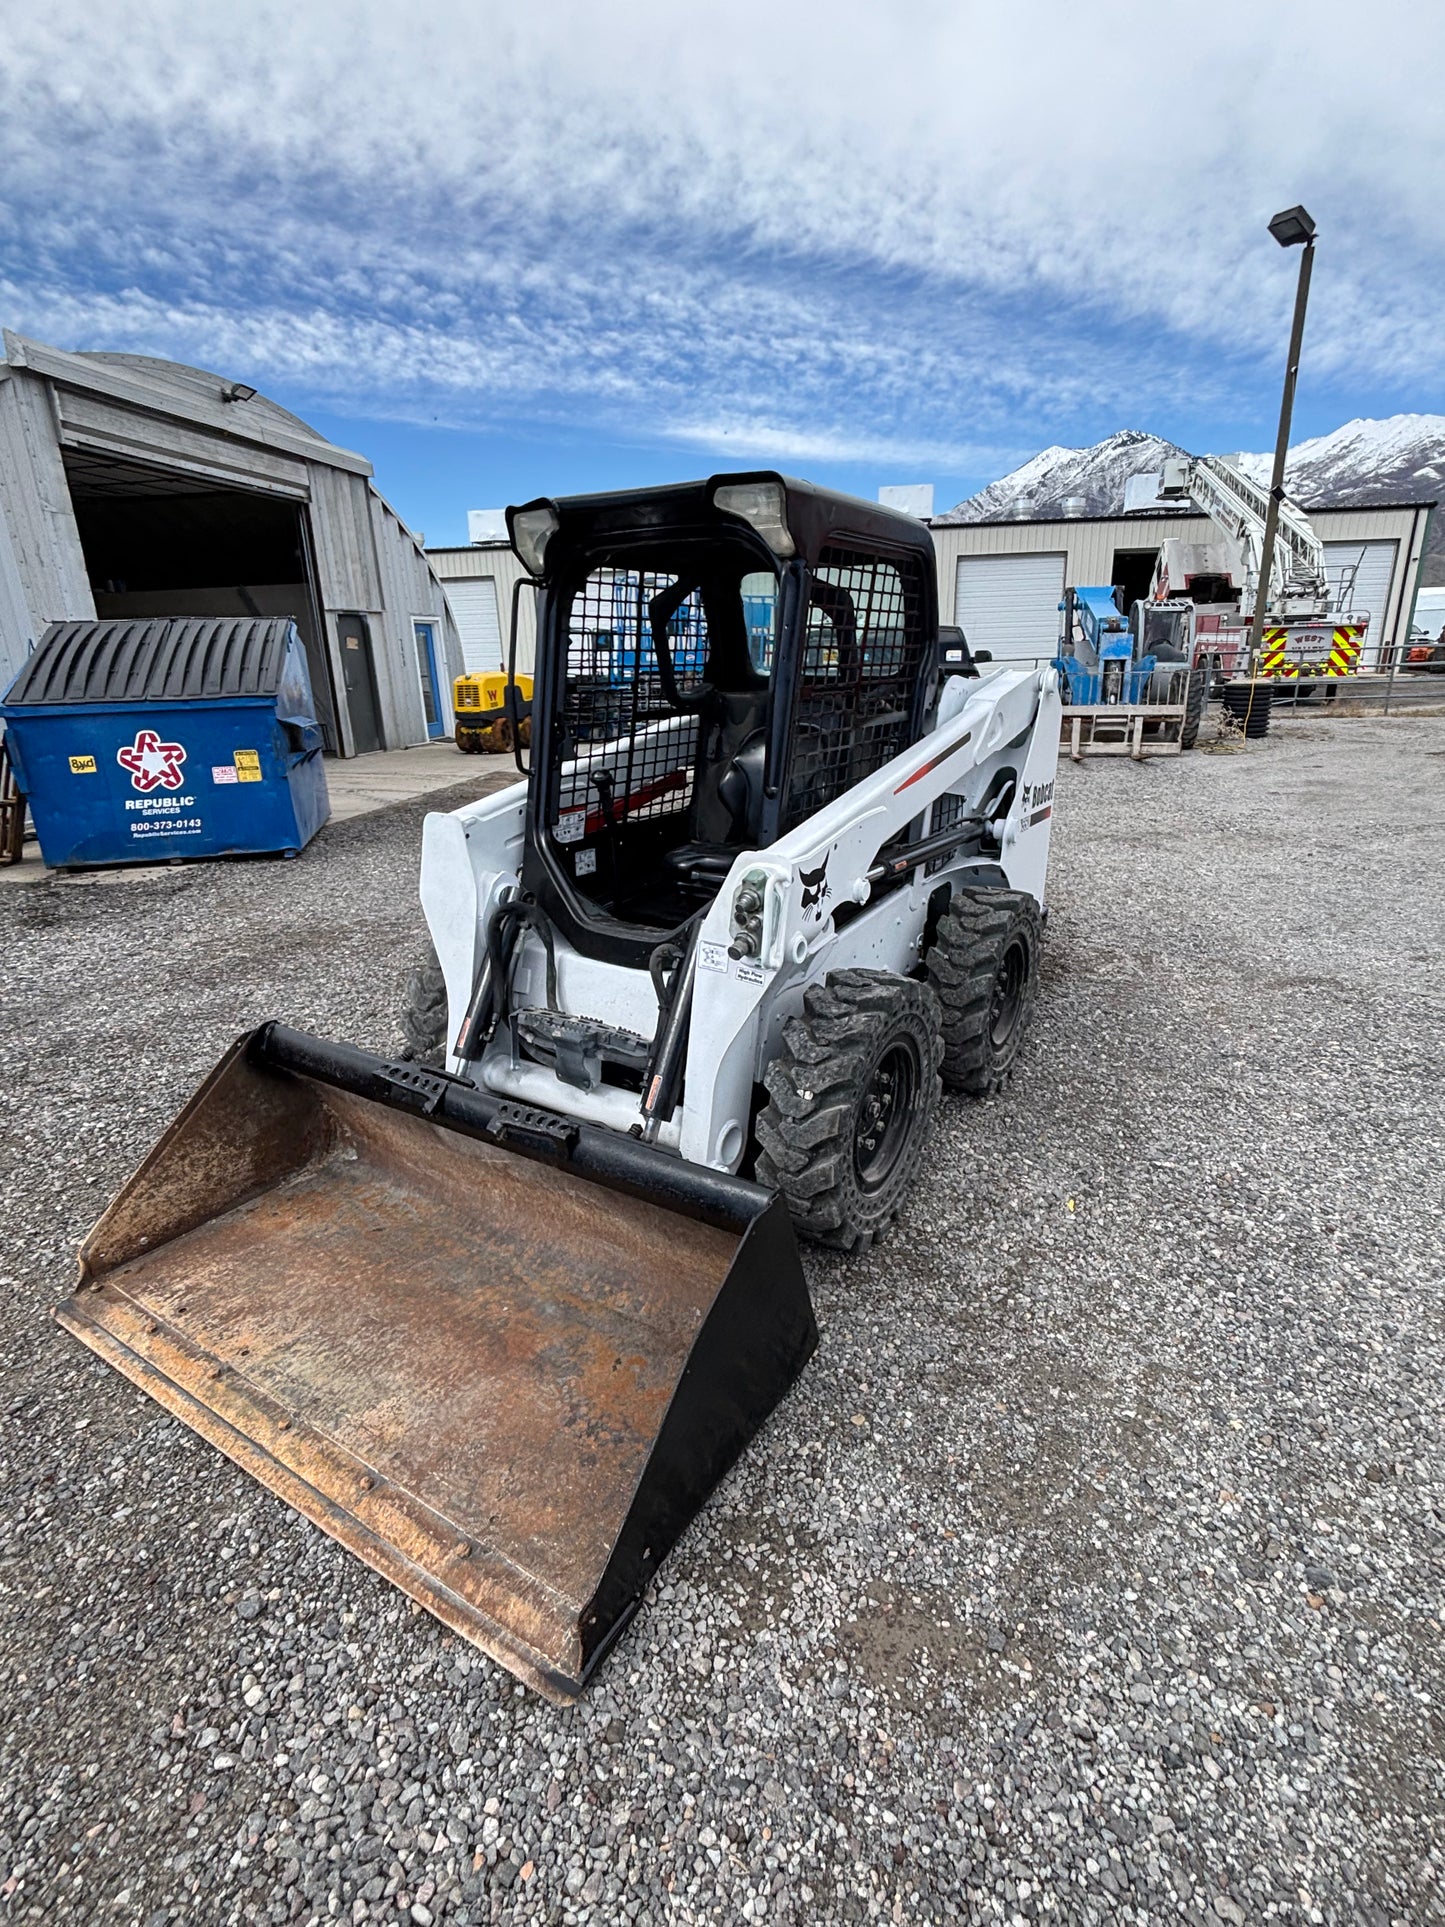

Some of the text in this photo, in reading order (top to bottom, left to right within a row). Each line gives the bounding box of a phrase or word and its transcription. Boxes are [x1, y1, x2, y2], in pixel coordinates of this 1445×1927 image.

[1294, 635, 1325, 644] WEST
[125, 796, 194, 810] REPUBLIC
[142, 807, 181, 816] SERVICES
[130, 818, 201, 831] 800-373-0143
[133, 829, 202, 838] RepublicServices.com
[739, 968, 750, 976] High
[737, 974, 763, 984] Hydraulics
